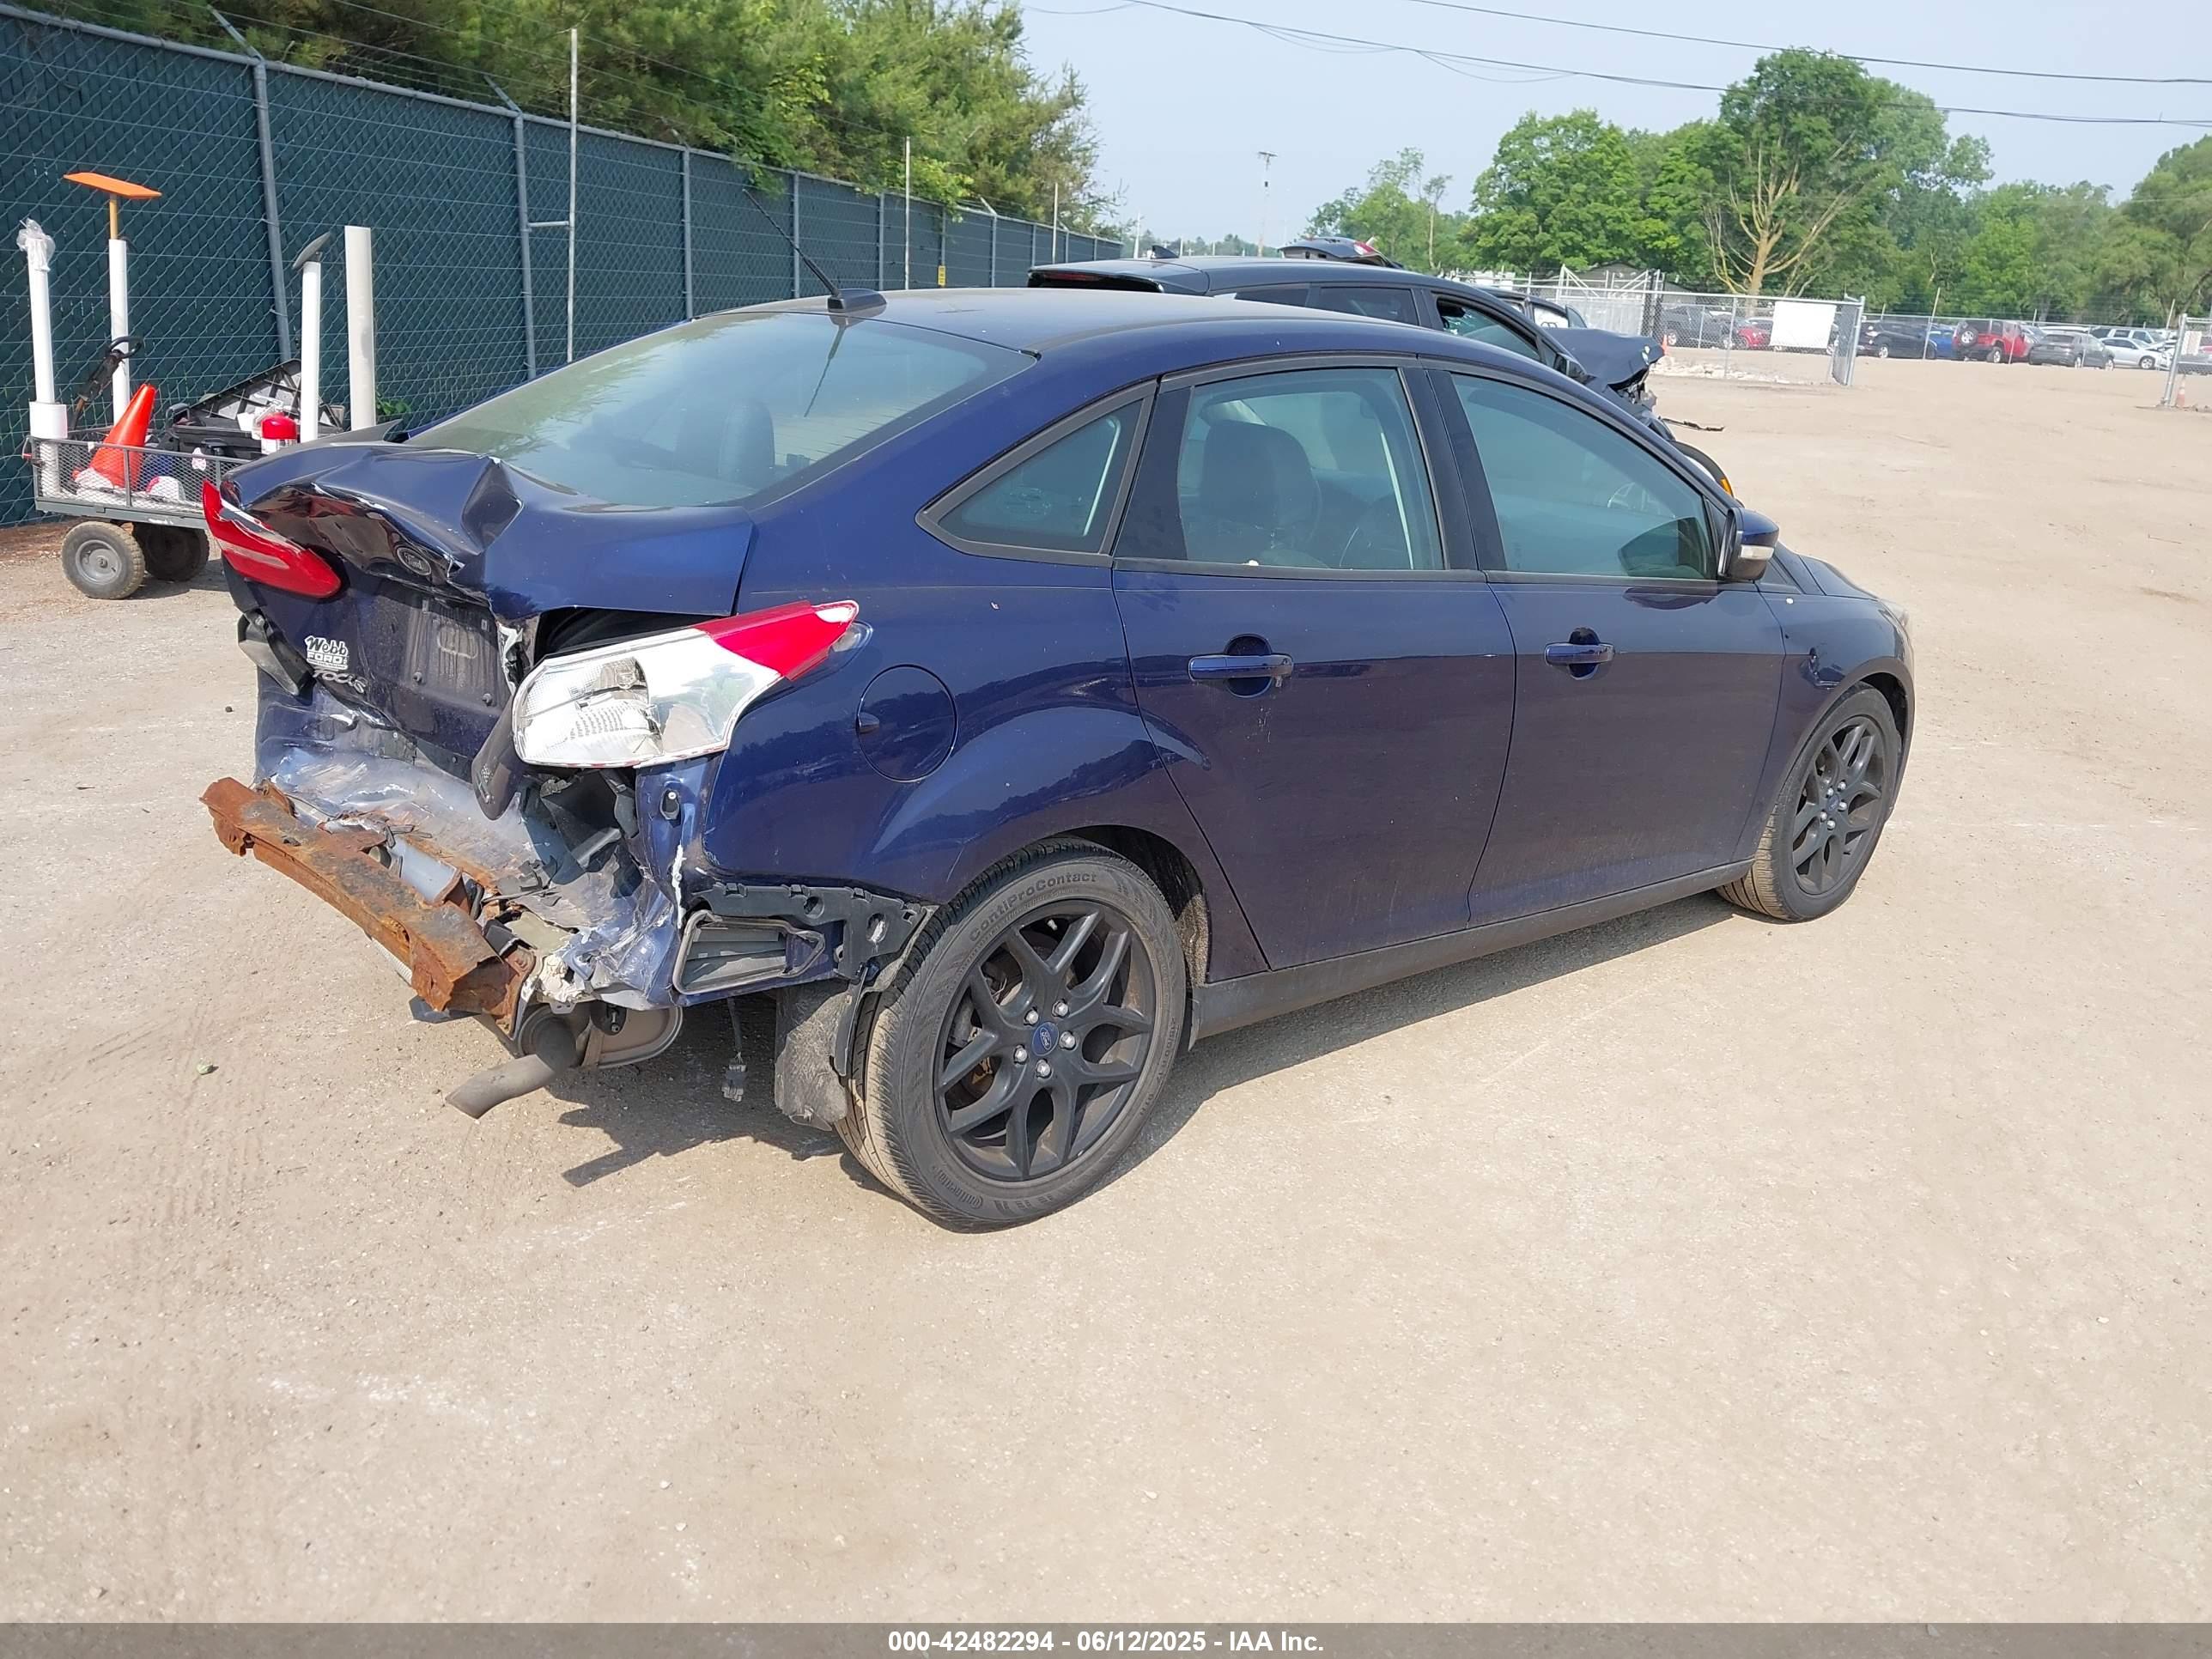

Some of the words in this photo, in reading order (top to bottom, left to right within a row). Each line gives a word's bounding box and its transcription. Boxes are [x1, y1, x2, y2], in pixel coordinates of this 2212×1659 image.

[305, 636, 348, 656] Webb
[307, 651, 343, 665] FORD
[969, 871, 1097, 942] ContiProContact
